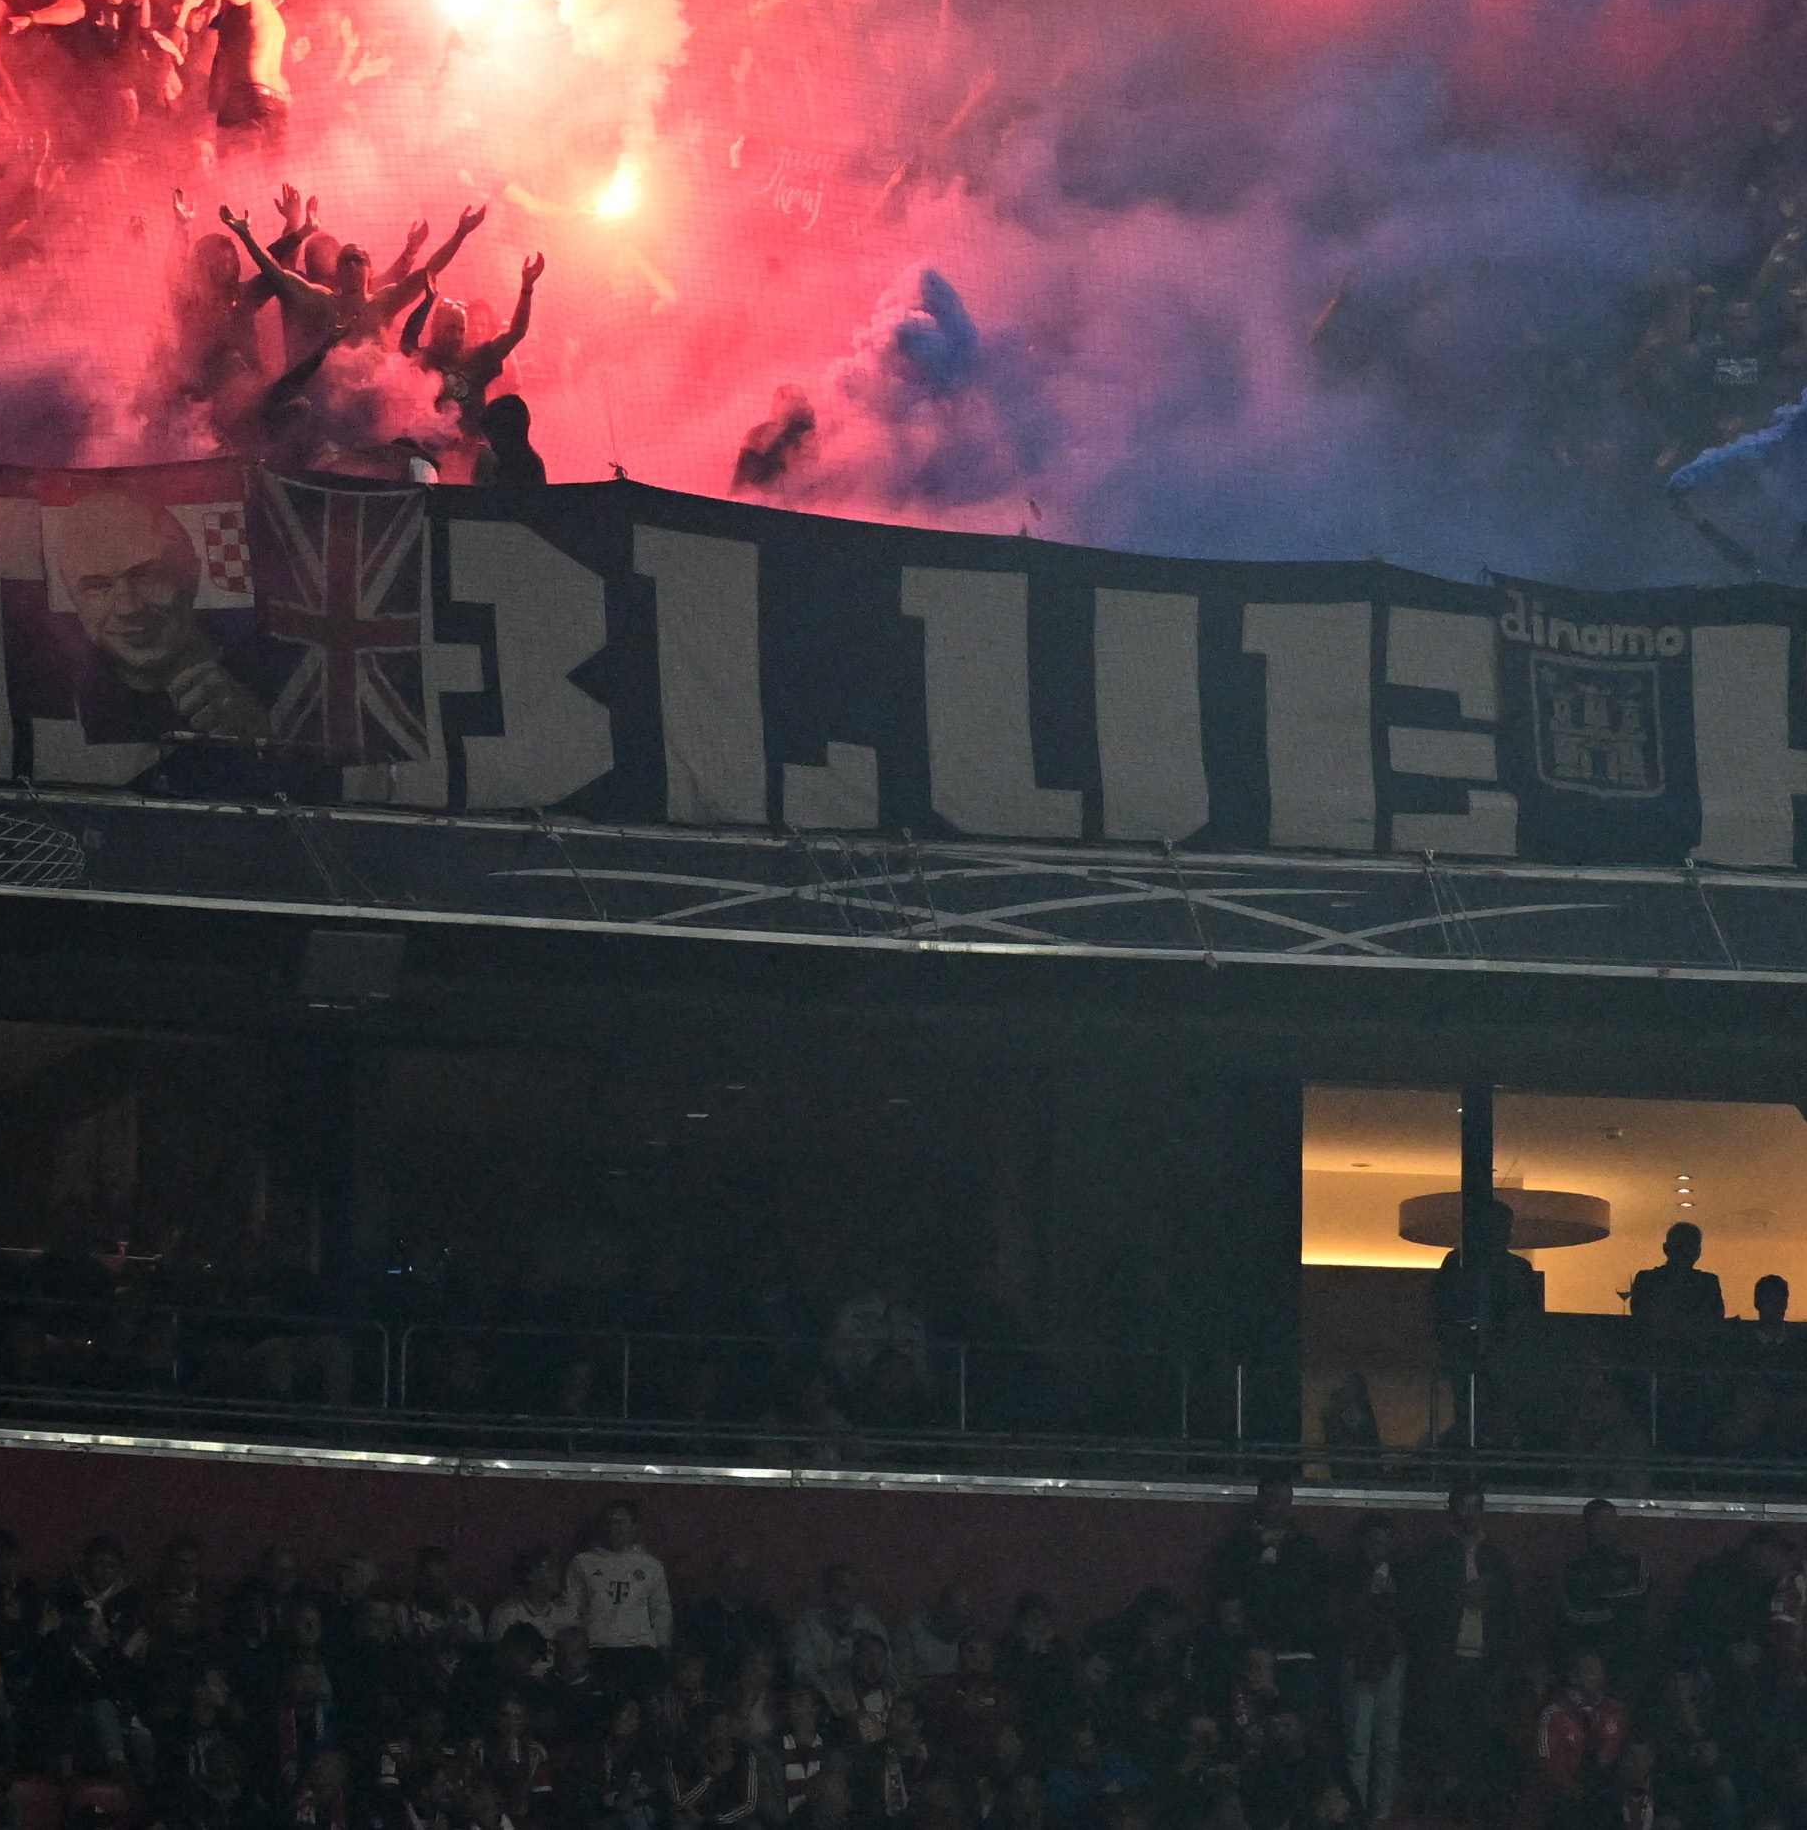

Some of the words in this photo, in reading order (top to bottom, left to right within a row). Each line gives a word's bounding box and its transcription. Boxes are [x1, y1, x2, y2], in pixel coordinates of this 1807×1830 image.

[1499, 589, 1686, 658] dinamo
[342, 517, 1519, 859] BLUE
[607, 1580, 630, 1605] T
